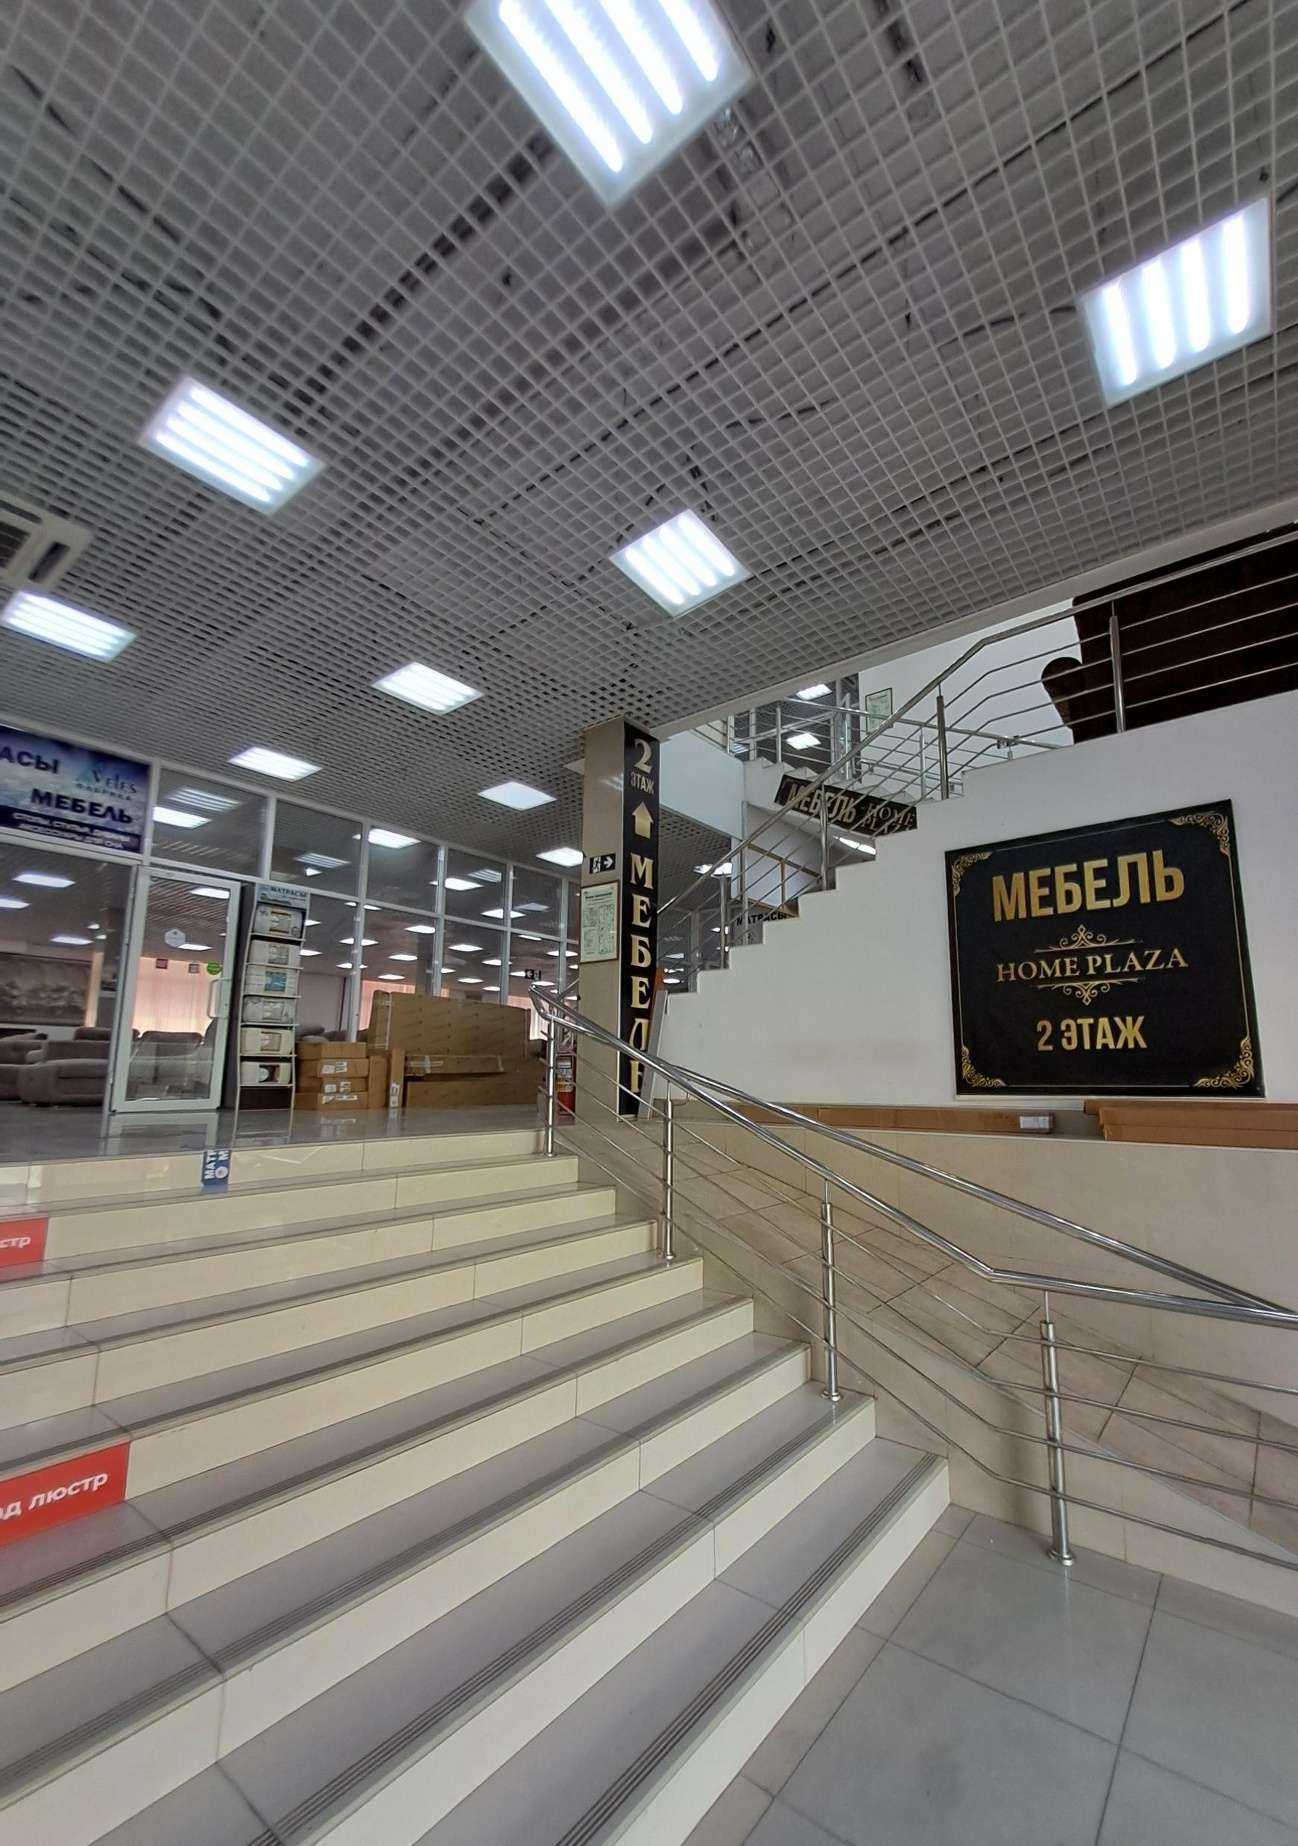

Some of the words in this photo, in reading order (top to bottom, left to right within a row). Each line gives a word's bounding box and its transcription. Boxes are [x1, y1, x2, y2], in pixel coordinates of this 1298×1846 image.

[634, 738, 653, 774] 2
[631, 771, 655, 795] ЭТАЖ
[30, 788, 133, 824] МЕБЕЛЬ
[992, 849, 1185, 922] МЕБЕЛЬ
[996, 956, 1080, 982] HOME
[1087, 947, 1189, 975] PLAZA
[1036, 1019, 1053, 1051] 2
[1060, 1015, 1147, 1050] ЭТАЖ
[28, 1473, 108, 1511] люстр
